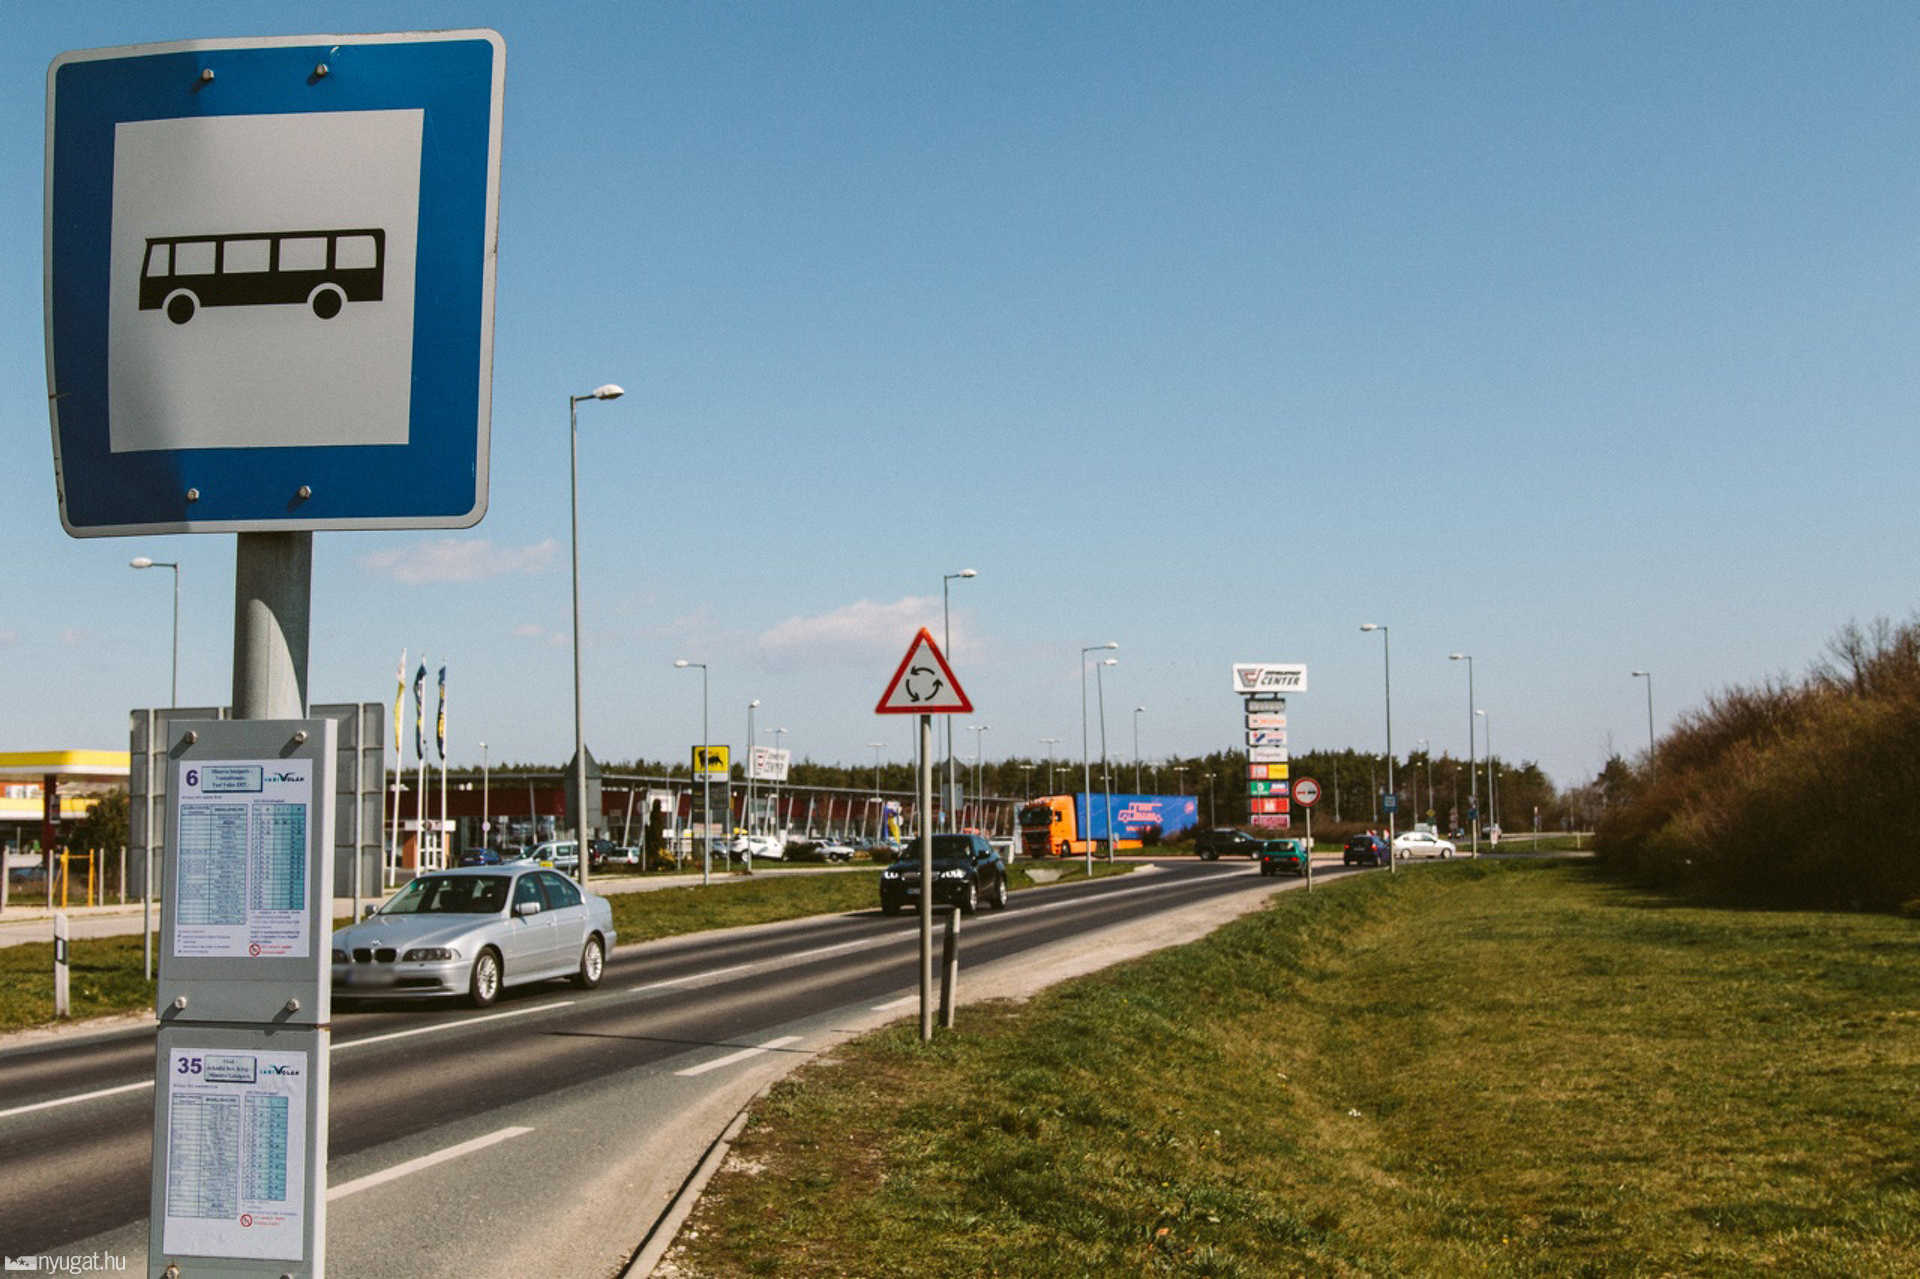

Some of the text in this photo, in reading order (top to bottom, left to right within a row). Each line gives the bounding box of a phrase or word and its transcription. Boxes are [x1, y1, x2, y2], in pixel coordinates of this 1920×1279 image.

[1261, 677, 1300, 685] CENTER
[186, 770, 198, 786] 6
[177, 1057, 202, 1074] 35
